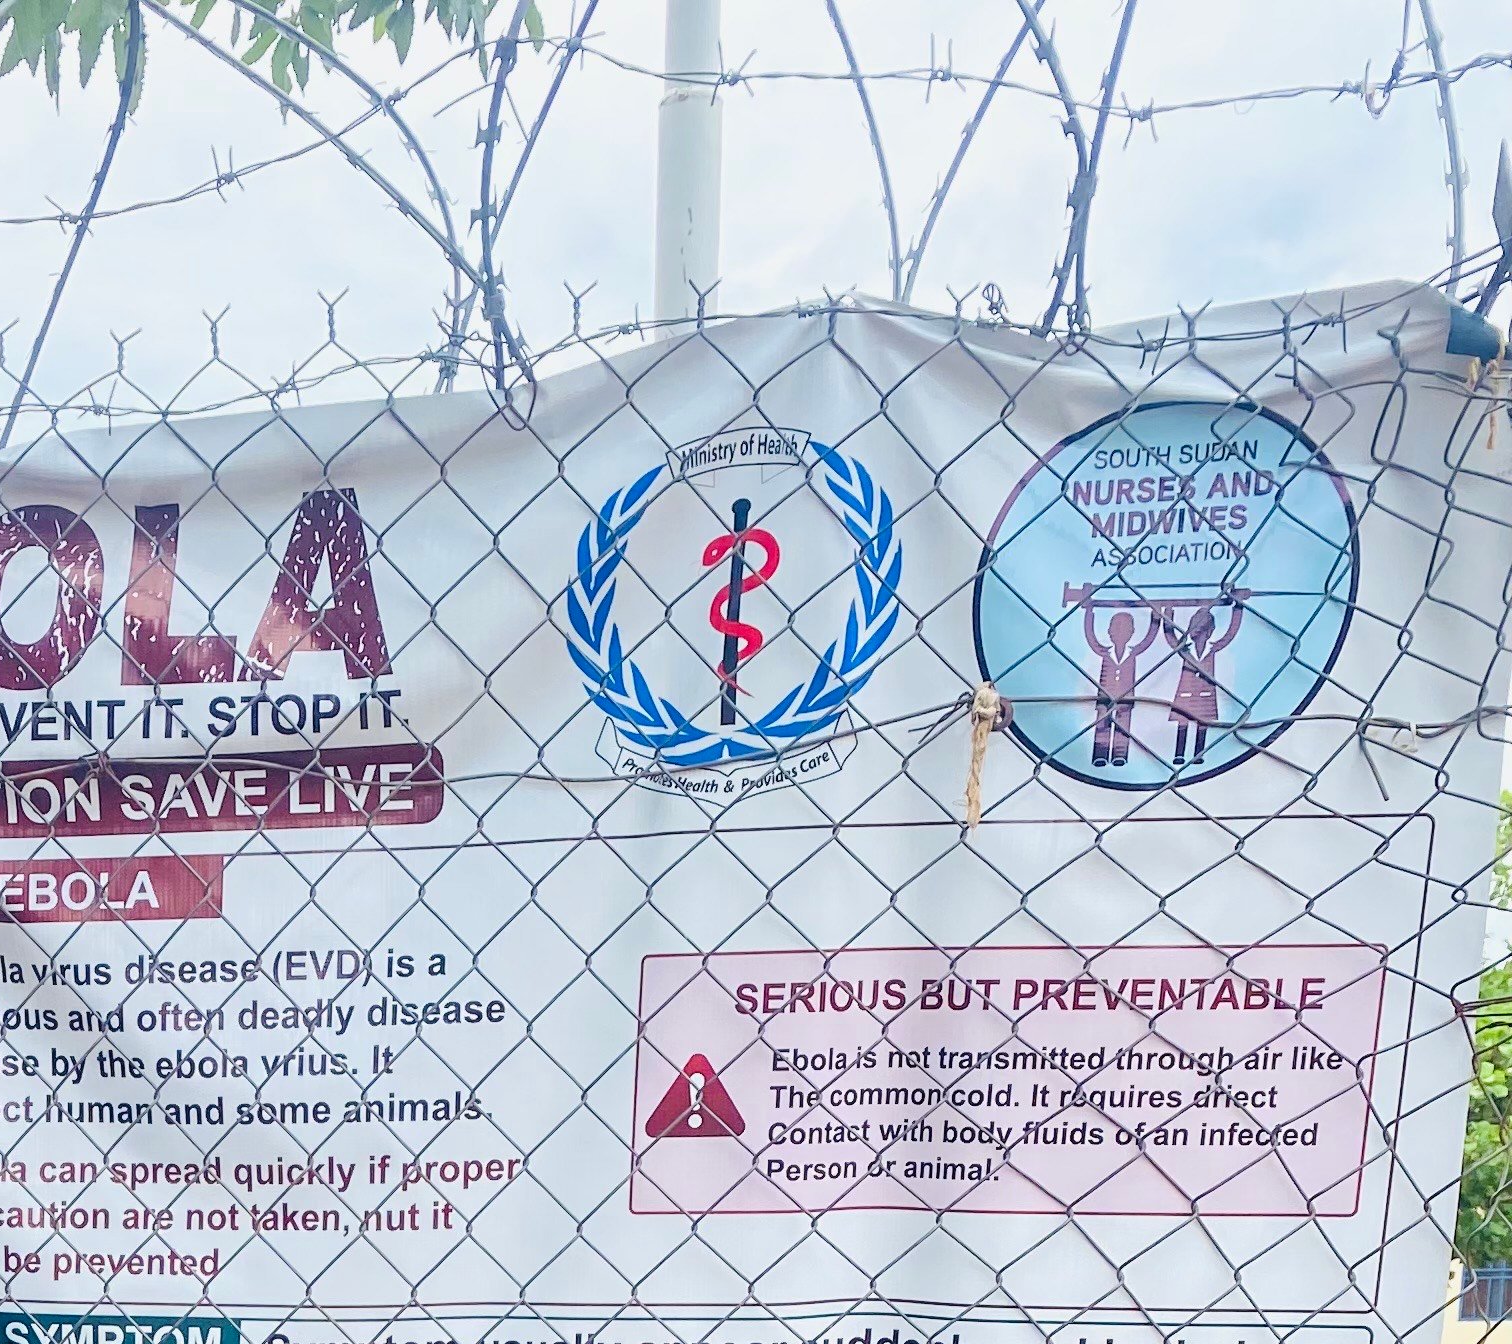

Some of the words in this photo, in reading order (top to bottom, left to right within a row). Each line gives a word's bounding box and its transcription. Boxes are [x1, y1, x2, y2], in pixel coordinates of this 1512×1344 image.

[740, 435, 754, 456] of
[1094, 445, 1171, 469] SOUTH
[1208, 470, 1274, 498] AND
[1091, 504, 1248, 539] MIDWIVES
[143, 697, 189, 740] IT.
[208, 694, 339, 737] STOP
[358, 690, 411, 732] IT.
[119, 769, 265, 822] SAVE
[289, 763, 414, 815] LIVE
[0, 870, 159, 911] EBOLA
[735, 980, 907, 1016] SERIOUS
[919, 979, 1000, 1010] BUT
[1012, 978, 1326, 1011] PREVENTABLE
[68, 1003, 125, 1032] and
[137, 1001, 224, 1033] often
[238, 998, 354, 1035] deadly
[367, 997, 506, 1027] disease
[51, 1049, 88, 1084] by
[97, 1050, 144, 1078] the
[156, 1049, 247, 1078] ebola
[261, 1047, 358, 1076] vrius.
[373, 1045, 394, 1075] It
[772, 1048, 849, 1071] Ebola
[856, 1049, 877, 1069] is
[887, 1048, 930, 1069] not
[938, 1048, 1105, 1071] transmitted
[1116, 1048, 1233, 1075] through
[1244, 1048, 1282, 1069] air
[1291, 1048, 1344, 1071] like
[45, 1095, 153, 1124] human
[164, 1097, 224, 1125] and
[237, 1101, 330, 1123] some
[343, 1091, 492, 1123] animals.
[38, 1160, 97, 1183] can
[109, 1154, 220, 1191] spread
[234, 1155, 354, 1191] quickly
[368, 1155, 390, 1184] if
[401, 1160, 521, 1190] proper
[4, 1249, 40, 1275] be
[54, 1249, 220, 1280] prevented
